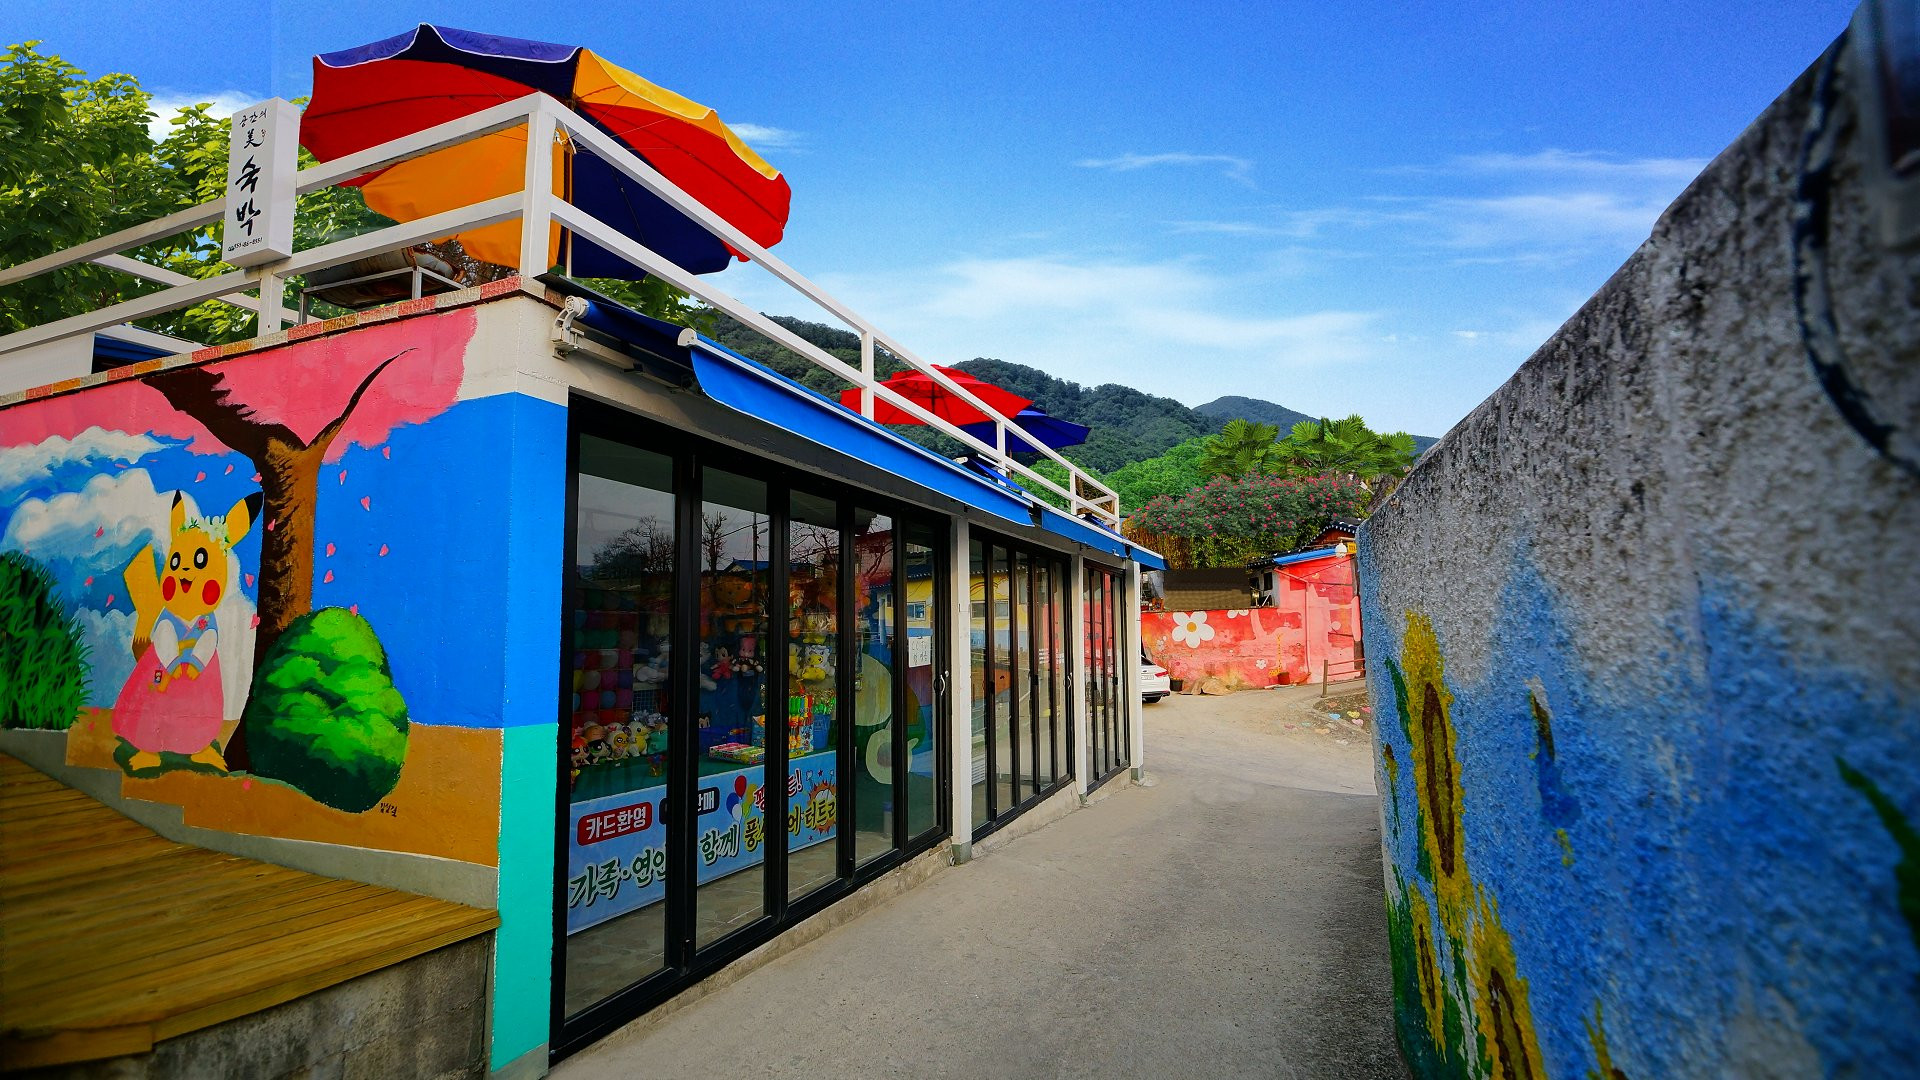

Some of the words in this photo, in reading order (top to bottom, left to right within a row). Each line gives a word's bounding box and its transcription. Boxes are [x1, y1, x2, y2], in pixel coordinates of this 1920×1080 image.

[235, 154, 262, 237] 숙박
[585, 805, 648, 841] 카드환영
[699, 822, 740, 864] 함께
